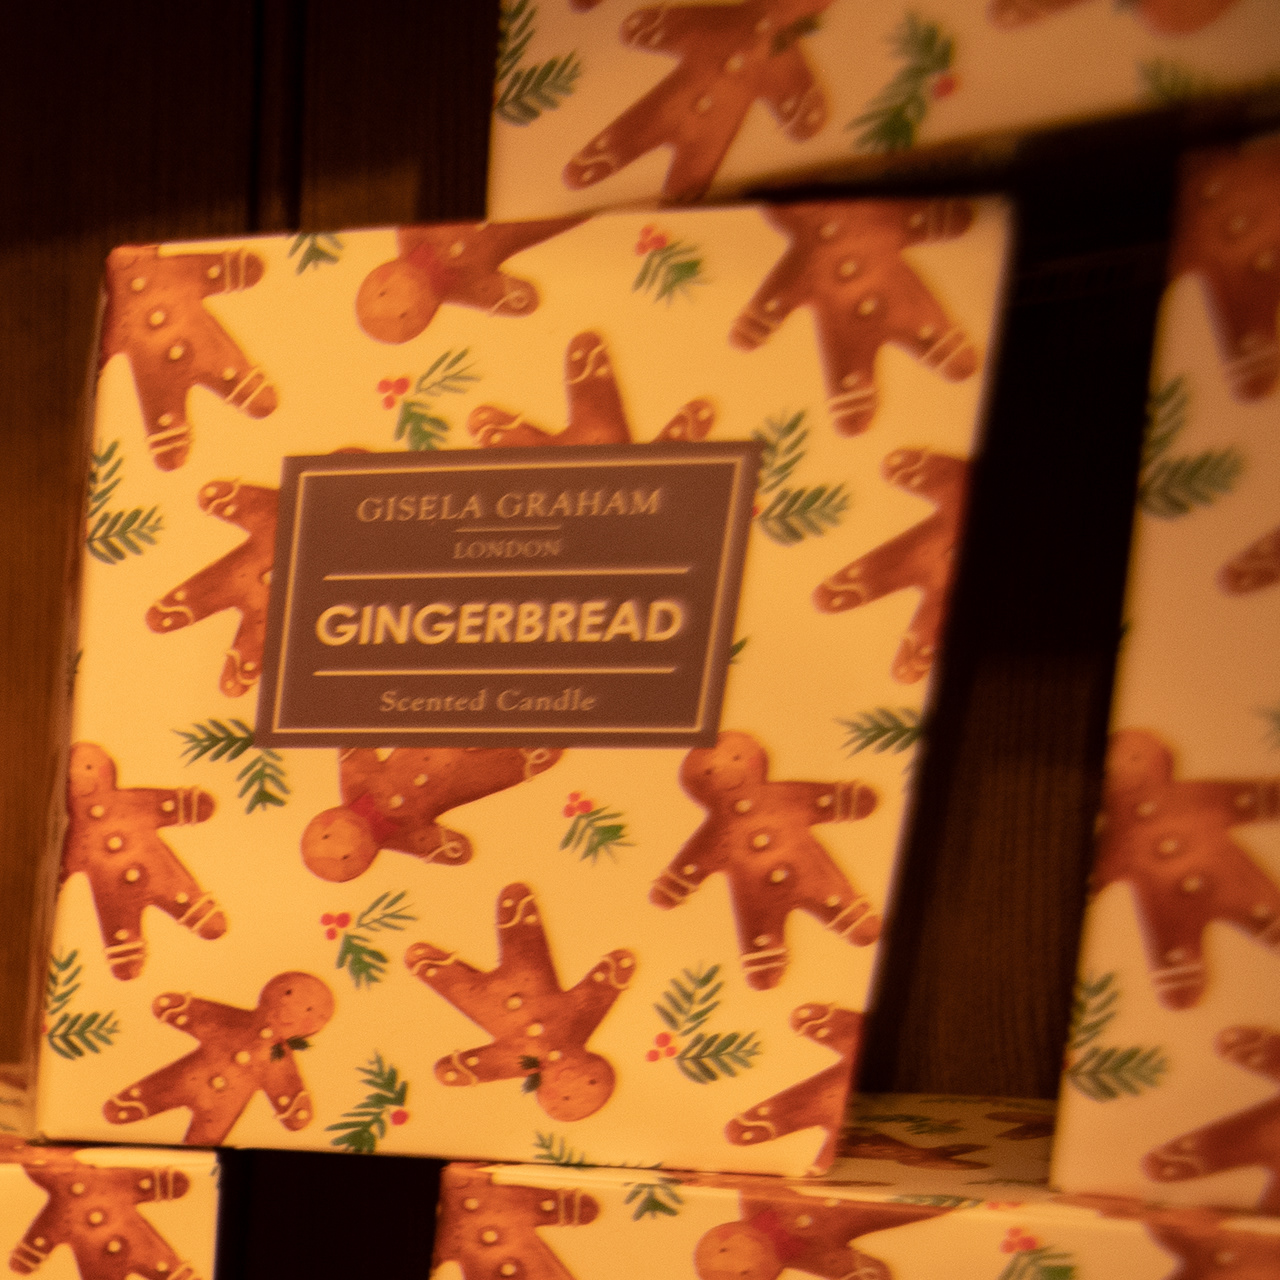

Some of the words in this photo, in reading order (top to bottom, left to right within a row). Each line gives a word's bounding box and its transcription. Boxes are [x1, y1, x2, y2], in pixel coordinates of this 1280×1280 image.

[356, 495, 483, 523] GISELA
[495, 488, 662, 519] GRAHAM
[452, 540, 563, 560] LONDON
[316, 600, 684, 646] GINGERBREAD
[379, 687, 487, 713] Scented
[496, 688, 598, 713] Candle
